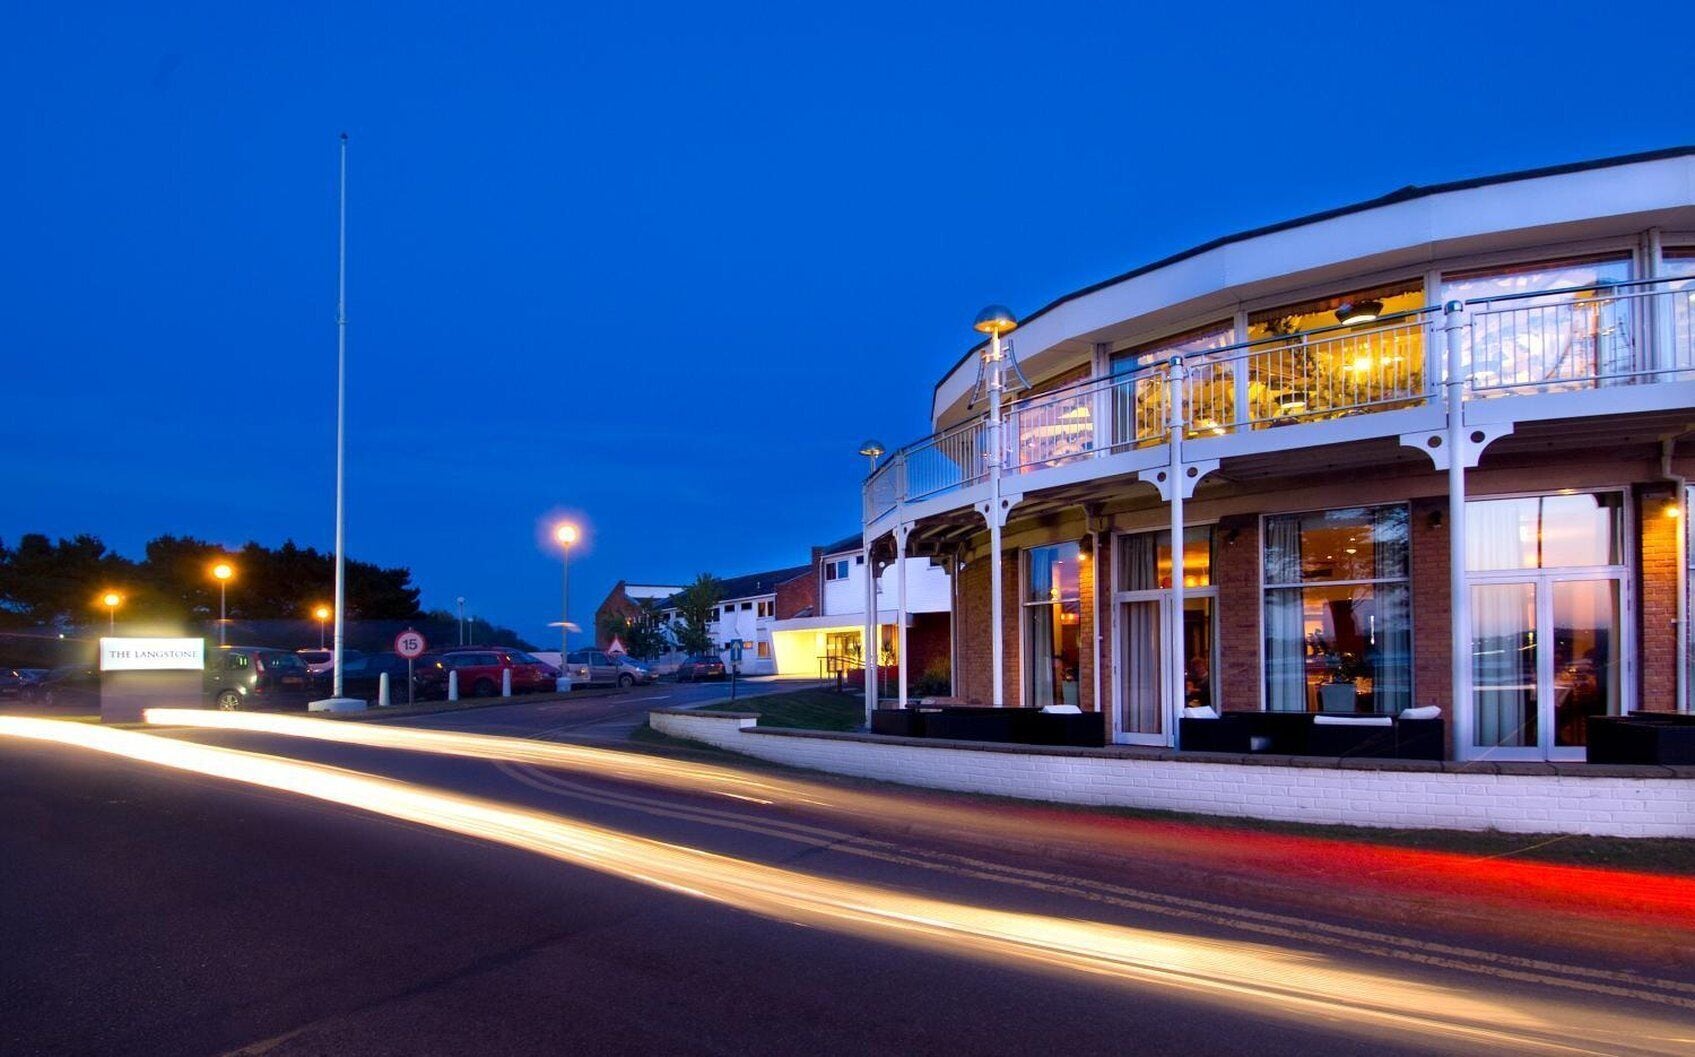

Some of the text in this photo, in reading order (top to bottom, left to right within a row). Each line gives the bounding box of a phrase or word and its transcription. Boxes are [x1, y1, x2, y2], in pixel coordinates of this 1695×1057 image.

[402, 639, 418, 650] 15
[109, 650, 197, 659] THE LANGSTONE
